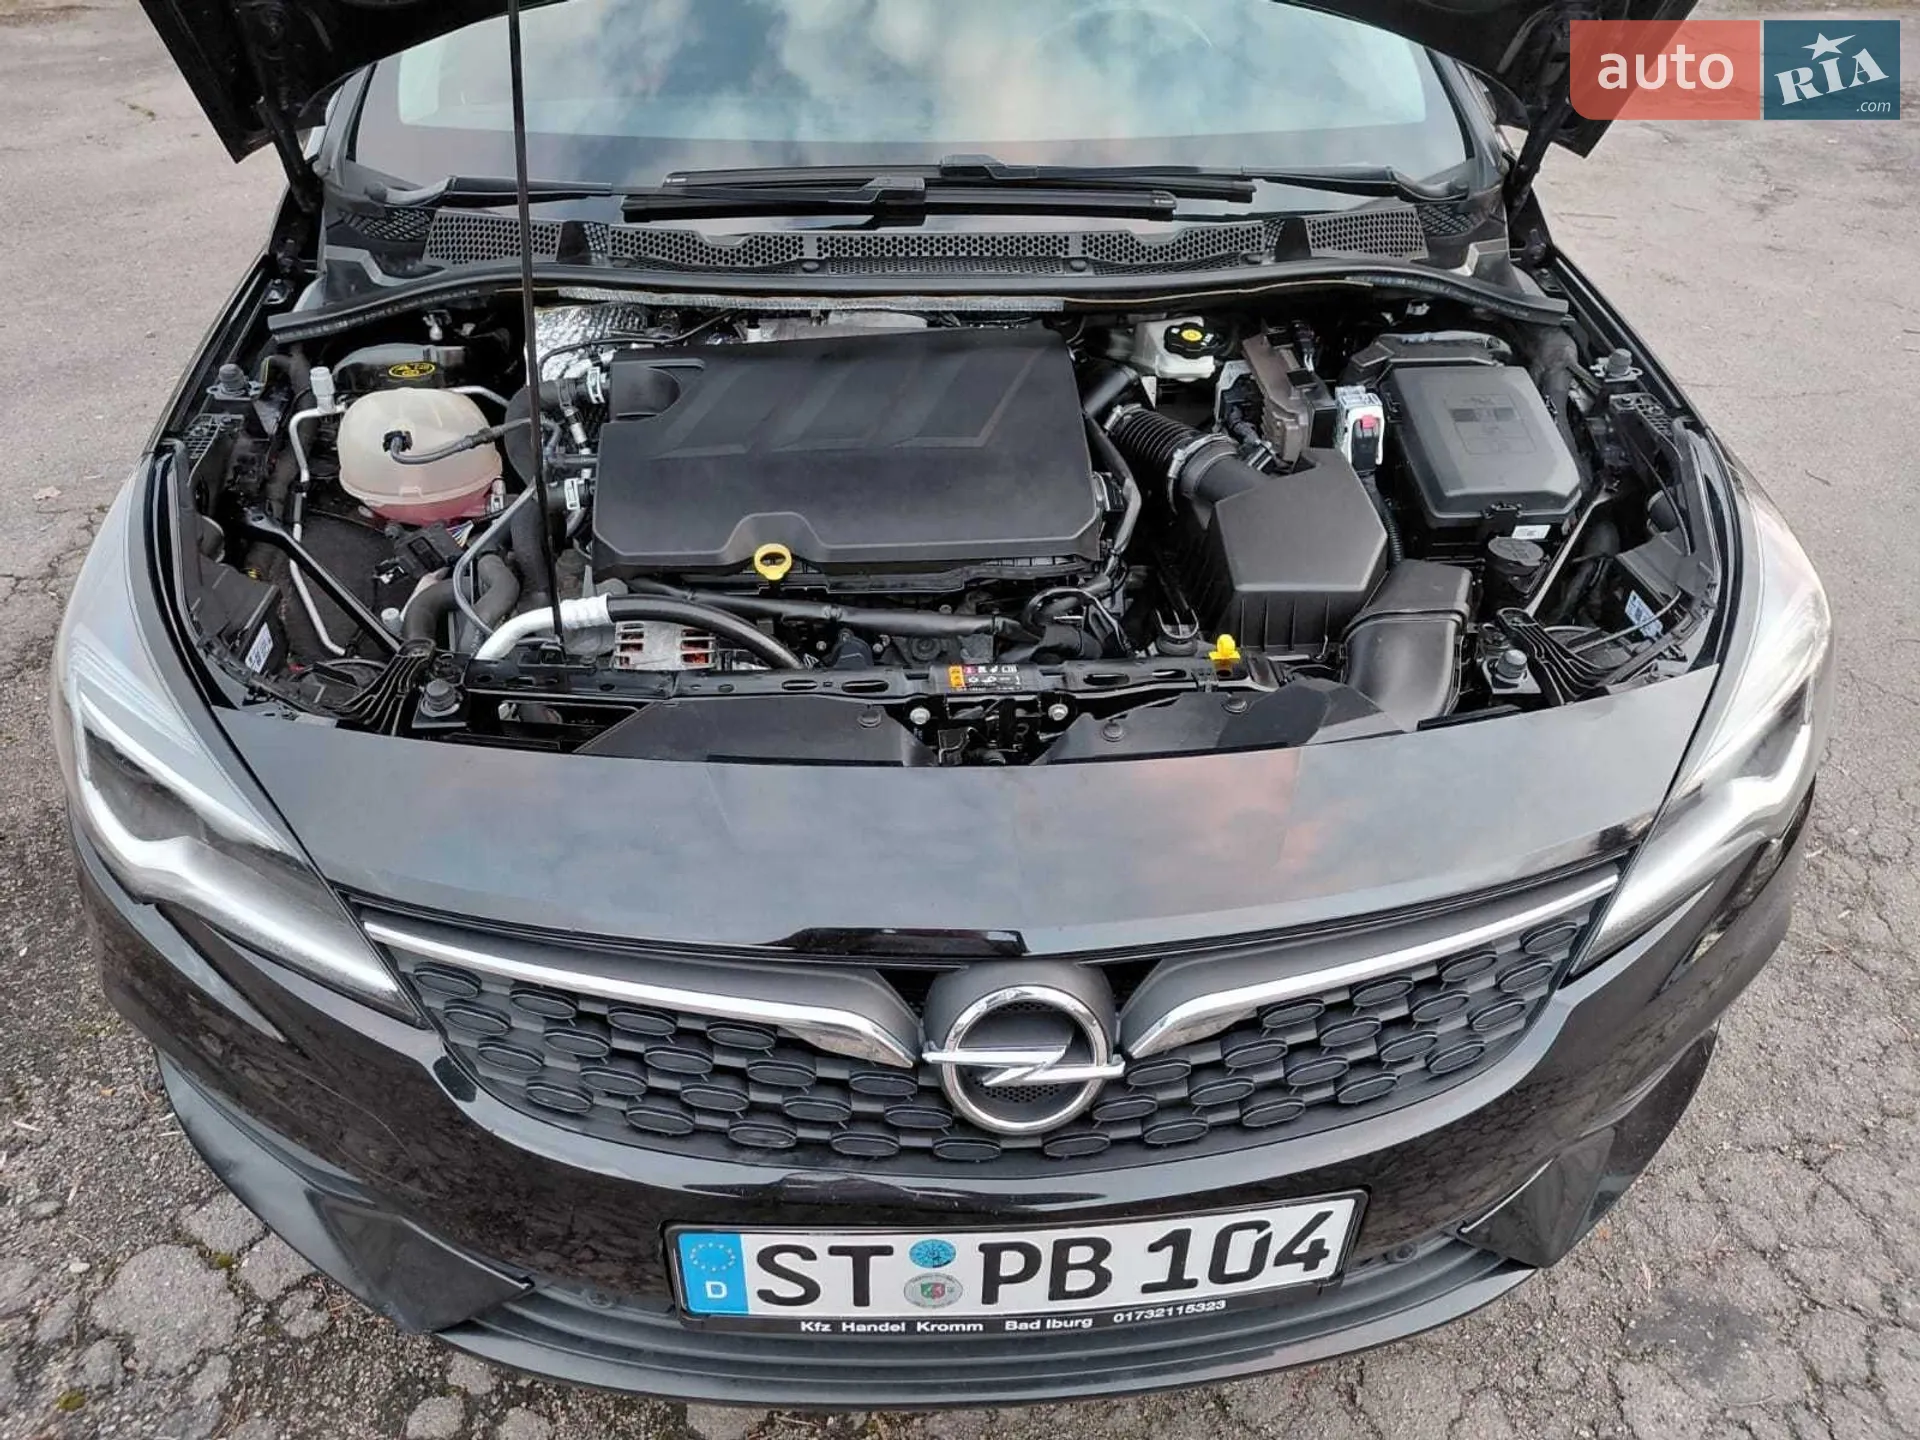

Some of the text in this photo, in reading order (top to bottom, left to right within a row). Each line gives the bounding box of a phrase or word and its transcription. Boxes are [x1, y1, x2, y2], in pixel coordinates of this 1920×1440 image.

[757, 1243, 894, 1307] ST
[979, 1236, 1112, 1306] PB
[1141, 1211, 1331, 1294] 104
[706, 1281, 727, 1298] D
[801, 1321, 832, 1332] Kfz
[842, 1321, 905, 1332] Handel
[916, 1321, 984, 1332] Kromm
[1004, 1319, 1040, 1331] Bad
[1046, 1318, 1093, 1329] Iburg
